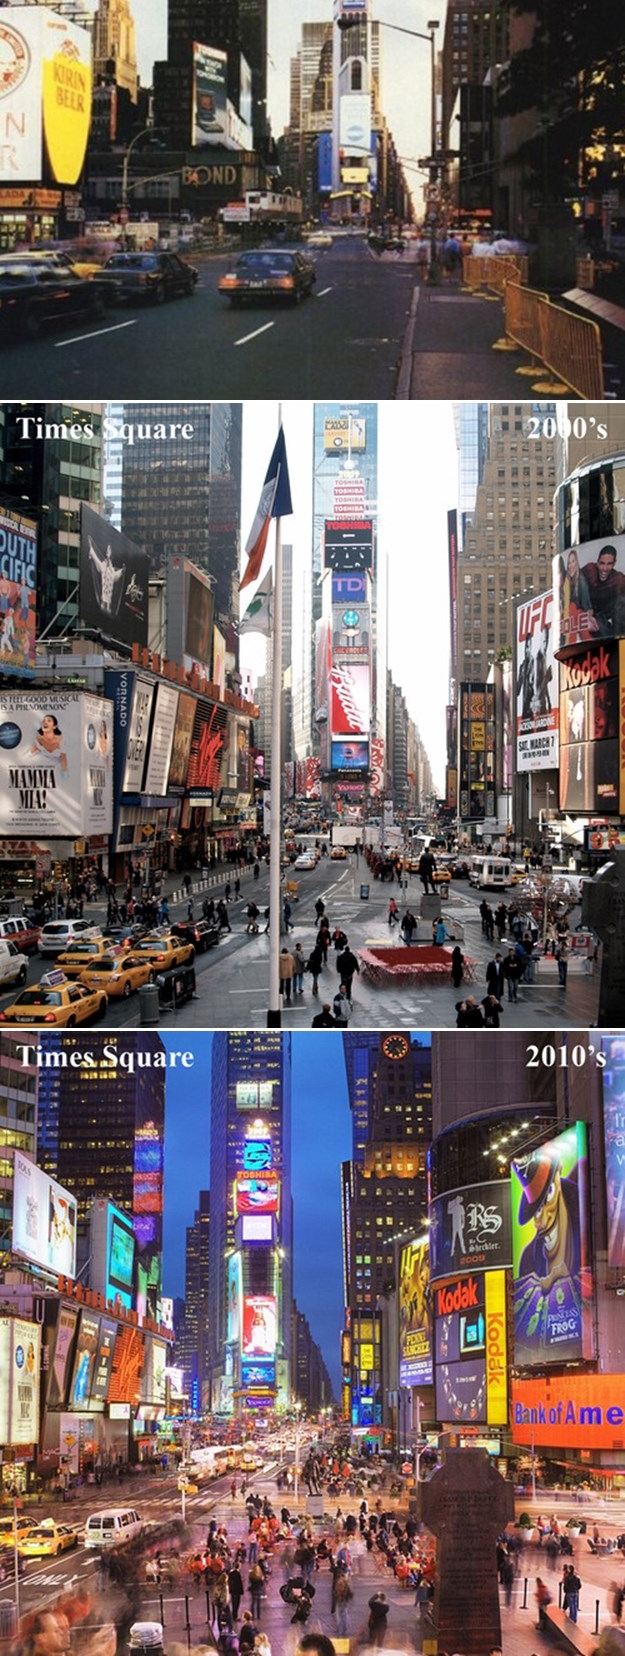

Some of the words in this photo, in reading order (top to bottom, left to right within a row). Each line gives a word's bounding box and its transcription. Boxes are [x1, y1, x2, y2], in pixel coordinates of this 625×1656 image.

[53, 62, 86, 92] KIRIN
[56, 86, 85, 113] BEER
[181, 165, 237, 186] BOND
[326, 521, 372, 530] TOSHIBA
[518, 594, 554, 644] UFC
[562, 646, 611, 691] Kodak
[49, 694, 80, 703] MUSICAL
[119, 672, 128, 728] VORNADO
[529, 737, 550, 750] MARCH
[8, 769, 57, 789] MAMMA
[18, 789, 47, 810] MIA!
[237, 1171, 278, 1179] TOSHIBA
[460, 1254, 486, 1265] 2009
[437, 1277, 479, 1316] Kodak
[550, 1318, 577, 1336] FROG
[487, 1312, 505, 1385] Kodak
[515, 1402, 546, 1425] Bank
[549, 1402, 563, 1425] of
[565, 1400, 624, 1426] Ame
